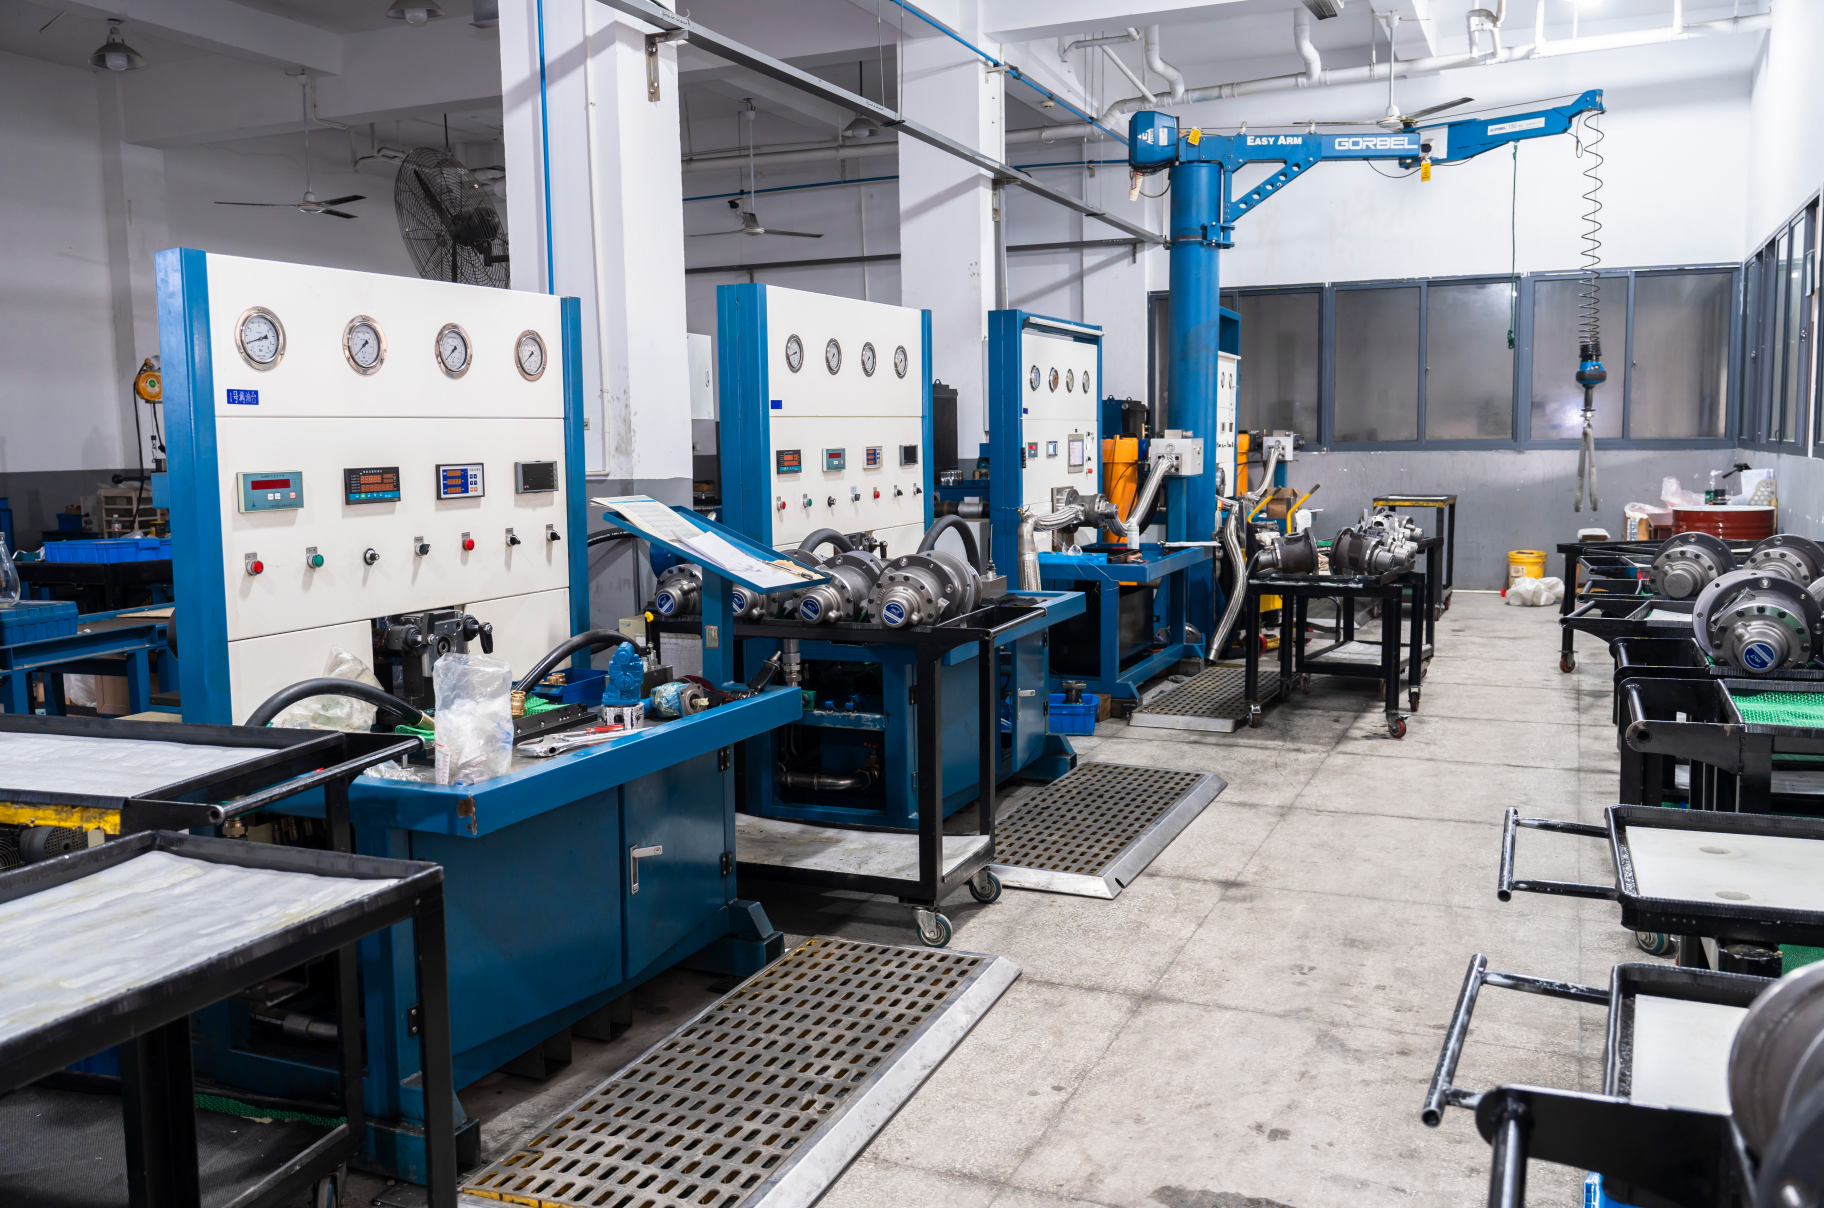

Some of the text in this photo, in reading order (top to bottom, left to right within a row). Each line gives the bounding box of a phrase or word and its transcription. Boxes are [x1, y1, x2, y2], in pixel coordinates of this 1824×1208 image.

[1246, 135, 1302, 146] EASY ARM
[1334, 137, 1418, 150] GORBEL
